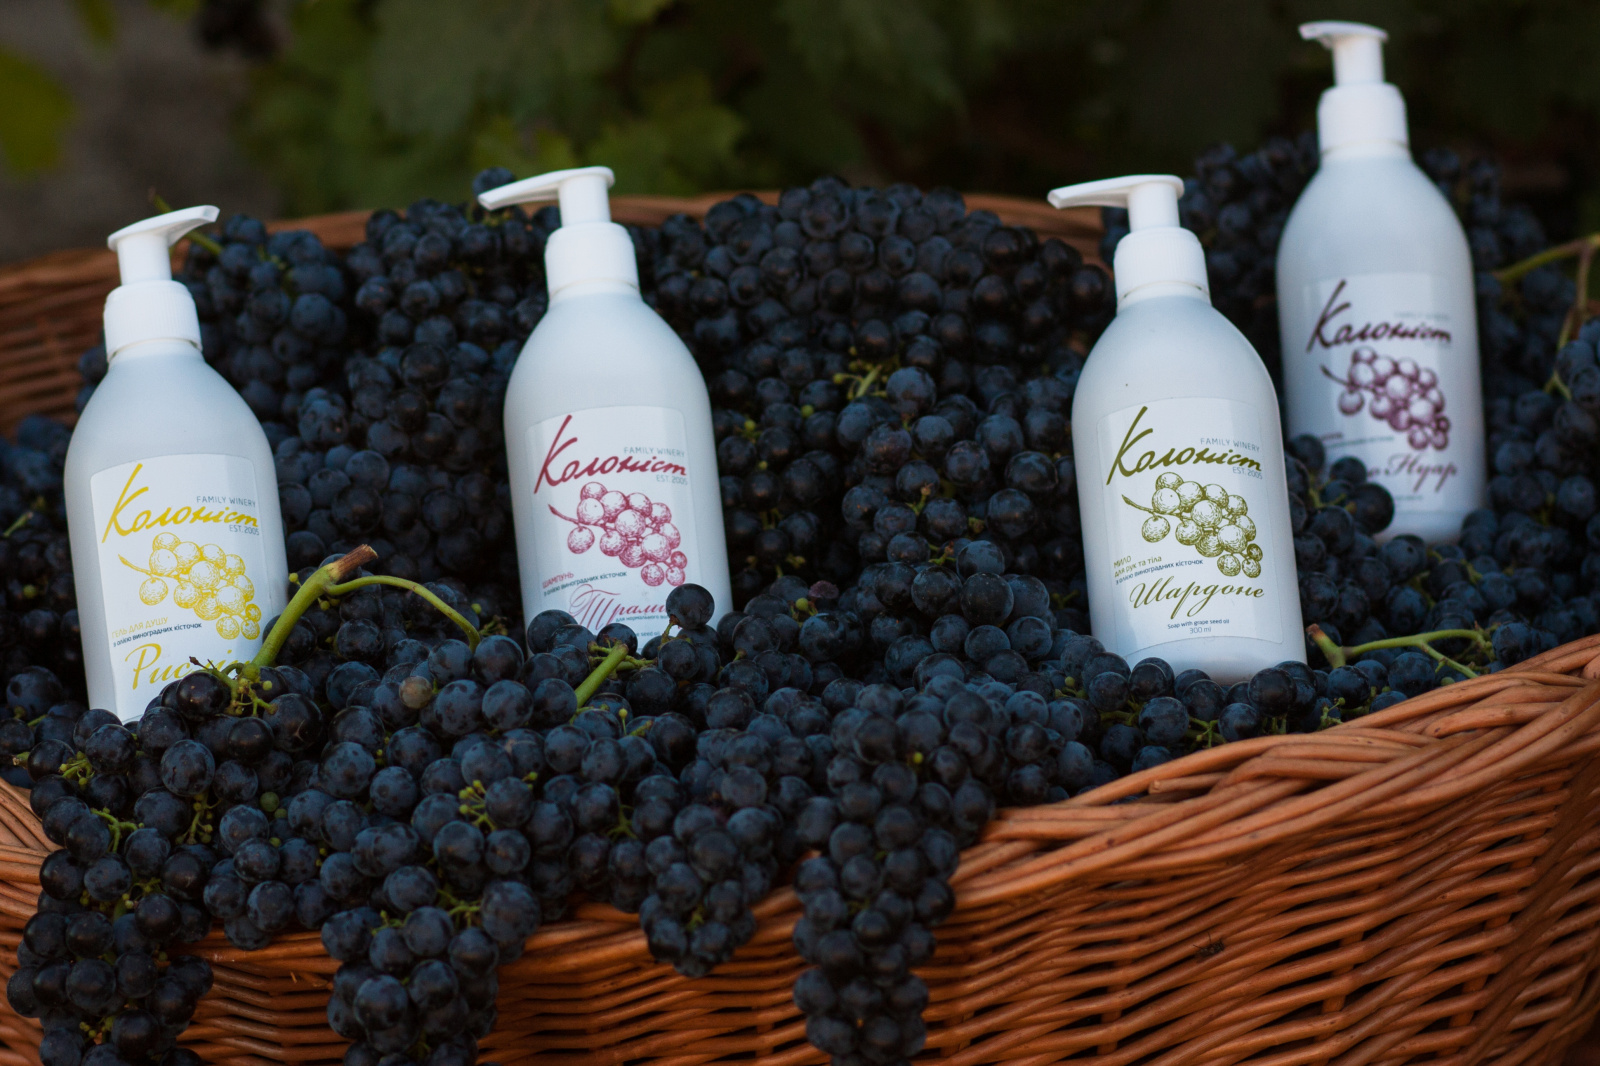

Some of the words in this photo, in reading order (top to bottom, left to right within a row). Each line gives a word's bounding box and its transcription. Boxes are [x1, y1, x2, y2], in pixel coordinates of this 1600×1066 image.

[624, 446, 654, 455] FAMILY
[656, 447, 685, 457] WINERY
[1106, 406, 1262, 485] Колоніст
[1200, 437, 1230, 446] FAMILY
[1233, 440, 1260, 452] WINERY
[533, 414, 687, 494] Колоніст
[671, 475, 688, 486] 2005
[1232, 466, 1246, 475] EST.
[1247, 468, 1263, 480] 2005
[101, 463, 259, 543] Колоніст
[196, 495, 227, 504] FAMILY
[229, 497, 256, 507] WINERY
[229, 525, 243, 533] EST.
[244, 526, 260, 536] 2005
[1113, 555, 1132, 569] МИЛО
[1114, 567, 1126, 578] для
[1125, 563, 1137, 573] рук
[1147, 556, 1162, 565] тіла
[1134, 563, 1175, 578] виноградних
[1175, 559, 1204, 568] кісточок
[542, 571, 574, 589] ШАМПУНЬ
[561, 575, 599, 590] виноградних
[599, 571, 628, 580] кісточок
[1129, 575, 1265, 620] Шардоне
[111, 627, 127, 639] ГЕЛЬ
[128, 622, 144, 634] ДЛЯ
[145, 616, 169, 629] ДУШУ
[132, 627, 173, 641] виноградних
[174, 622, 202, 631] кісточок
[1167, 622, 1181, 630] Soap
[1181, 620, 1193, 628] with
[1193, 619, 1209, 627] grape
